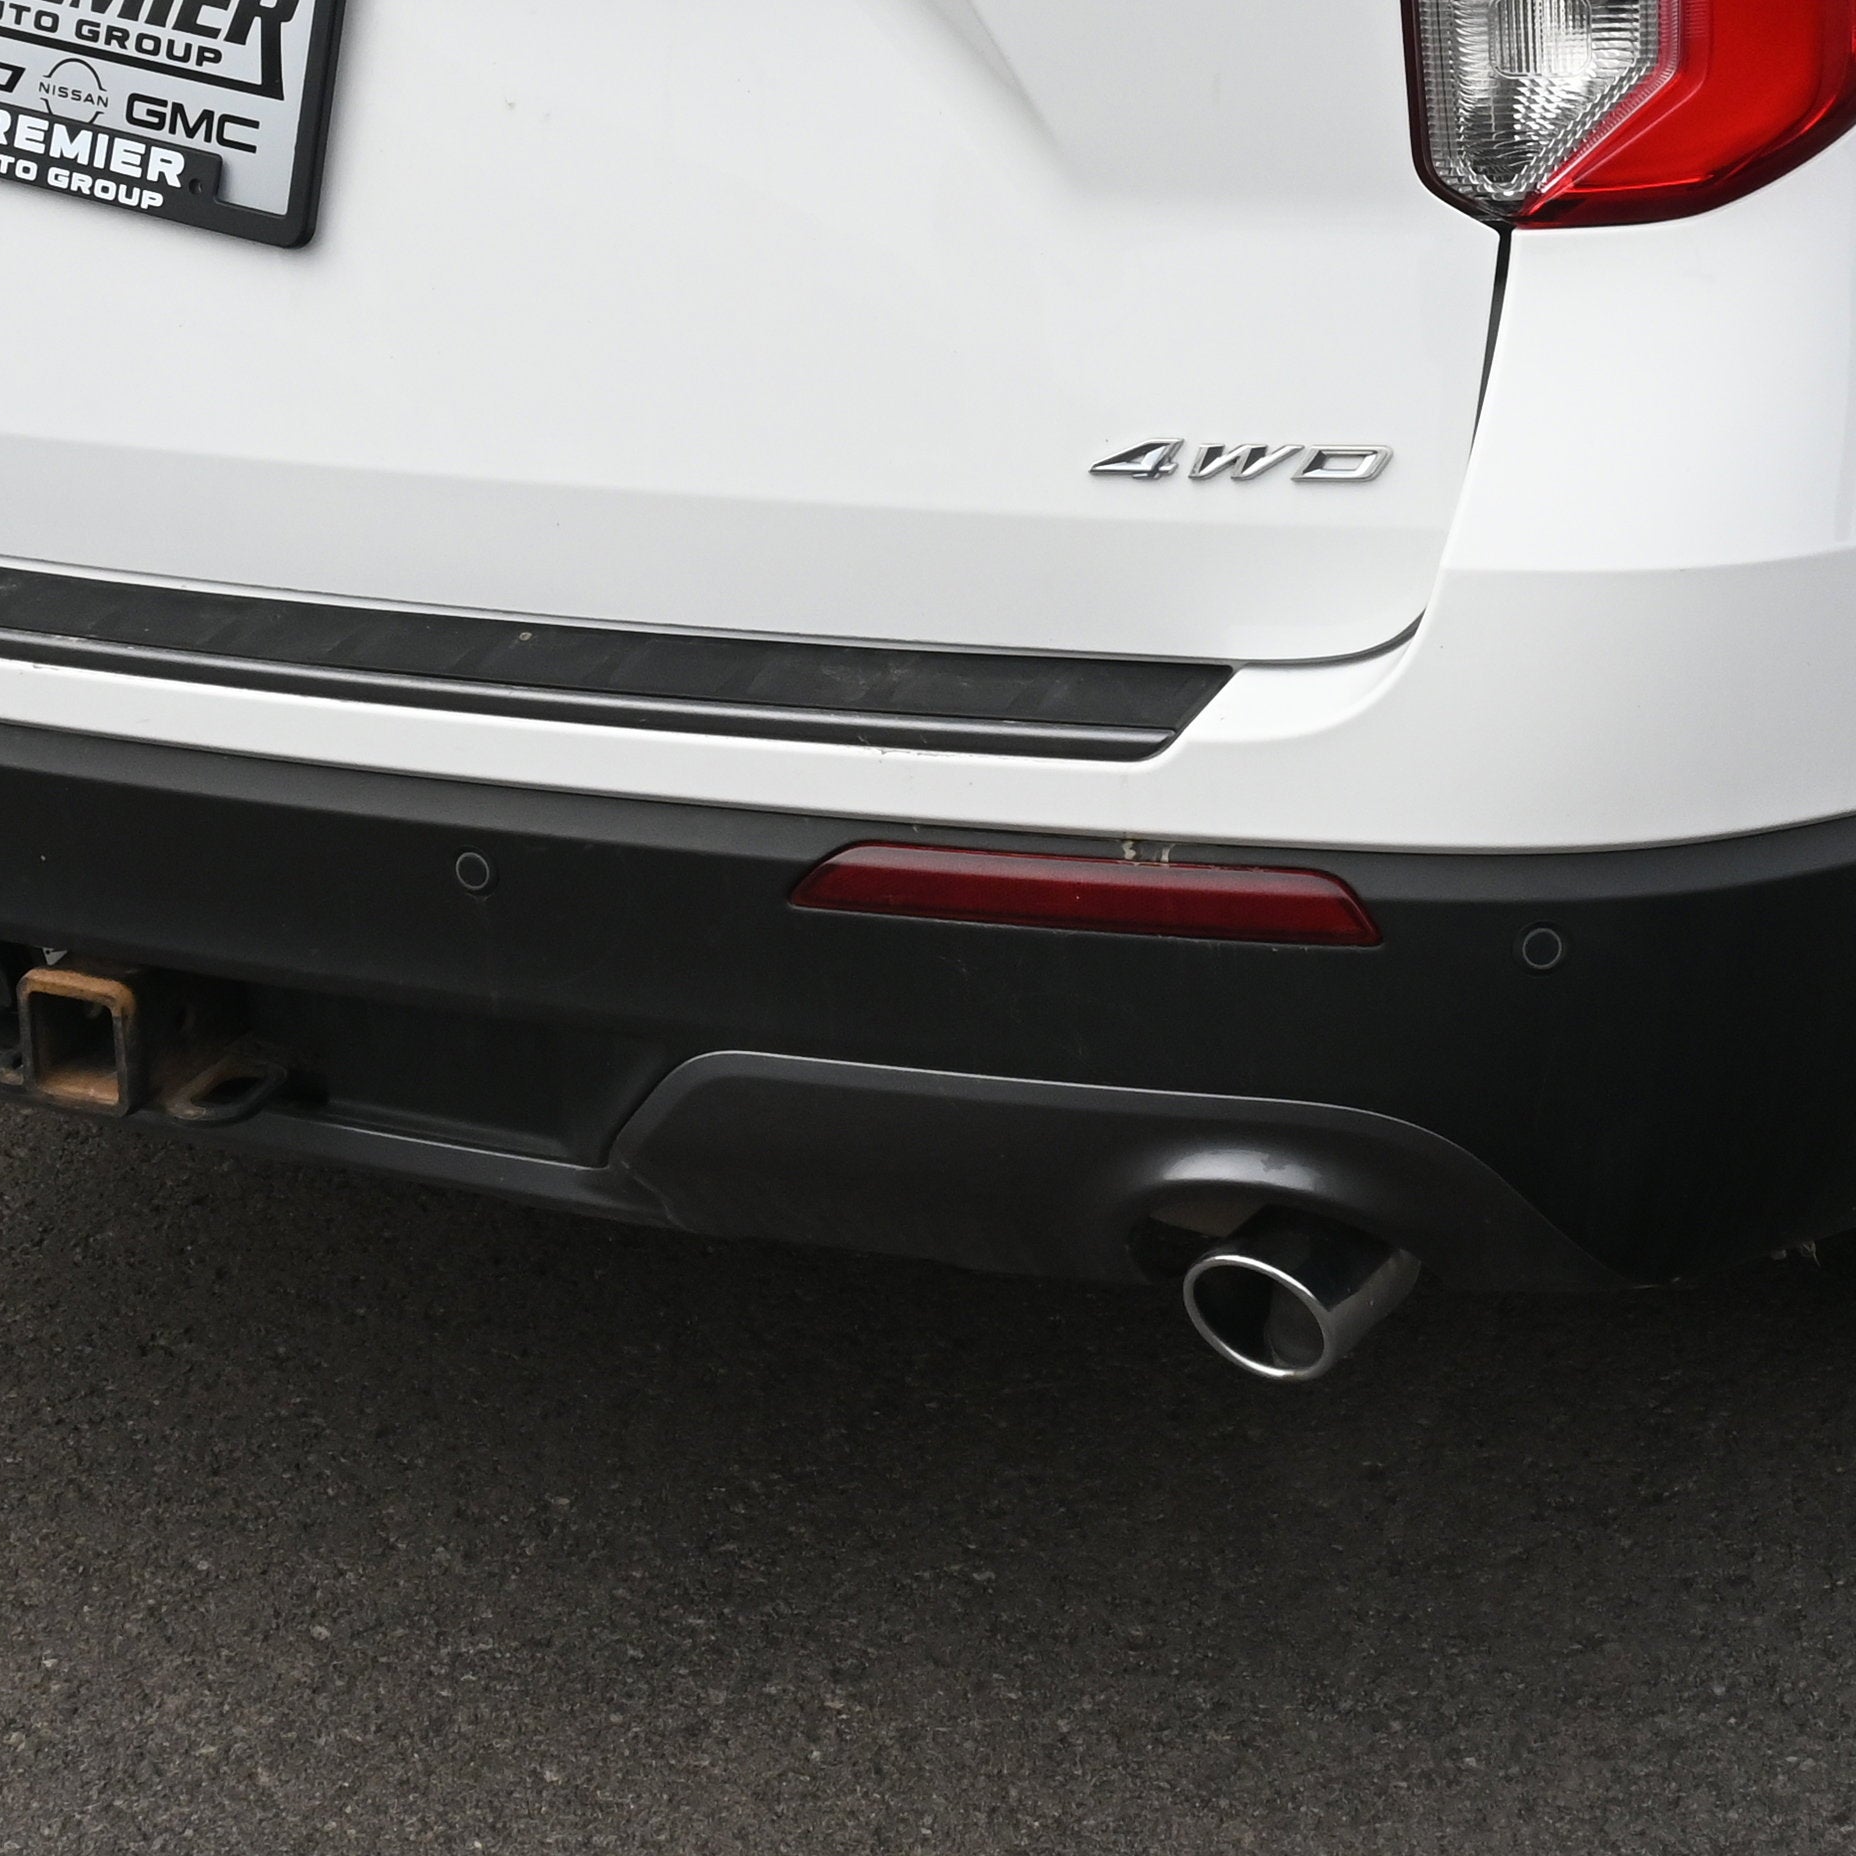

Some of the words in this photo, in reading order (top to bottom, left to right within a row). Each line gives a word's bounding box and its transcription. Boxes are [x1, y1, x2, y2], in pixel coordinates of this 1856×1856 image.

[74, 19, 223, 67] GROUP
[38, 81, 109, 108] NISSAN
[125, 92, 261, 155] GMC
[47, 168, 164, 211] GROUP
[1087, 437, 1394, 483] 4WD
